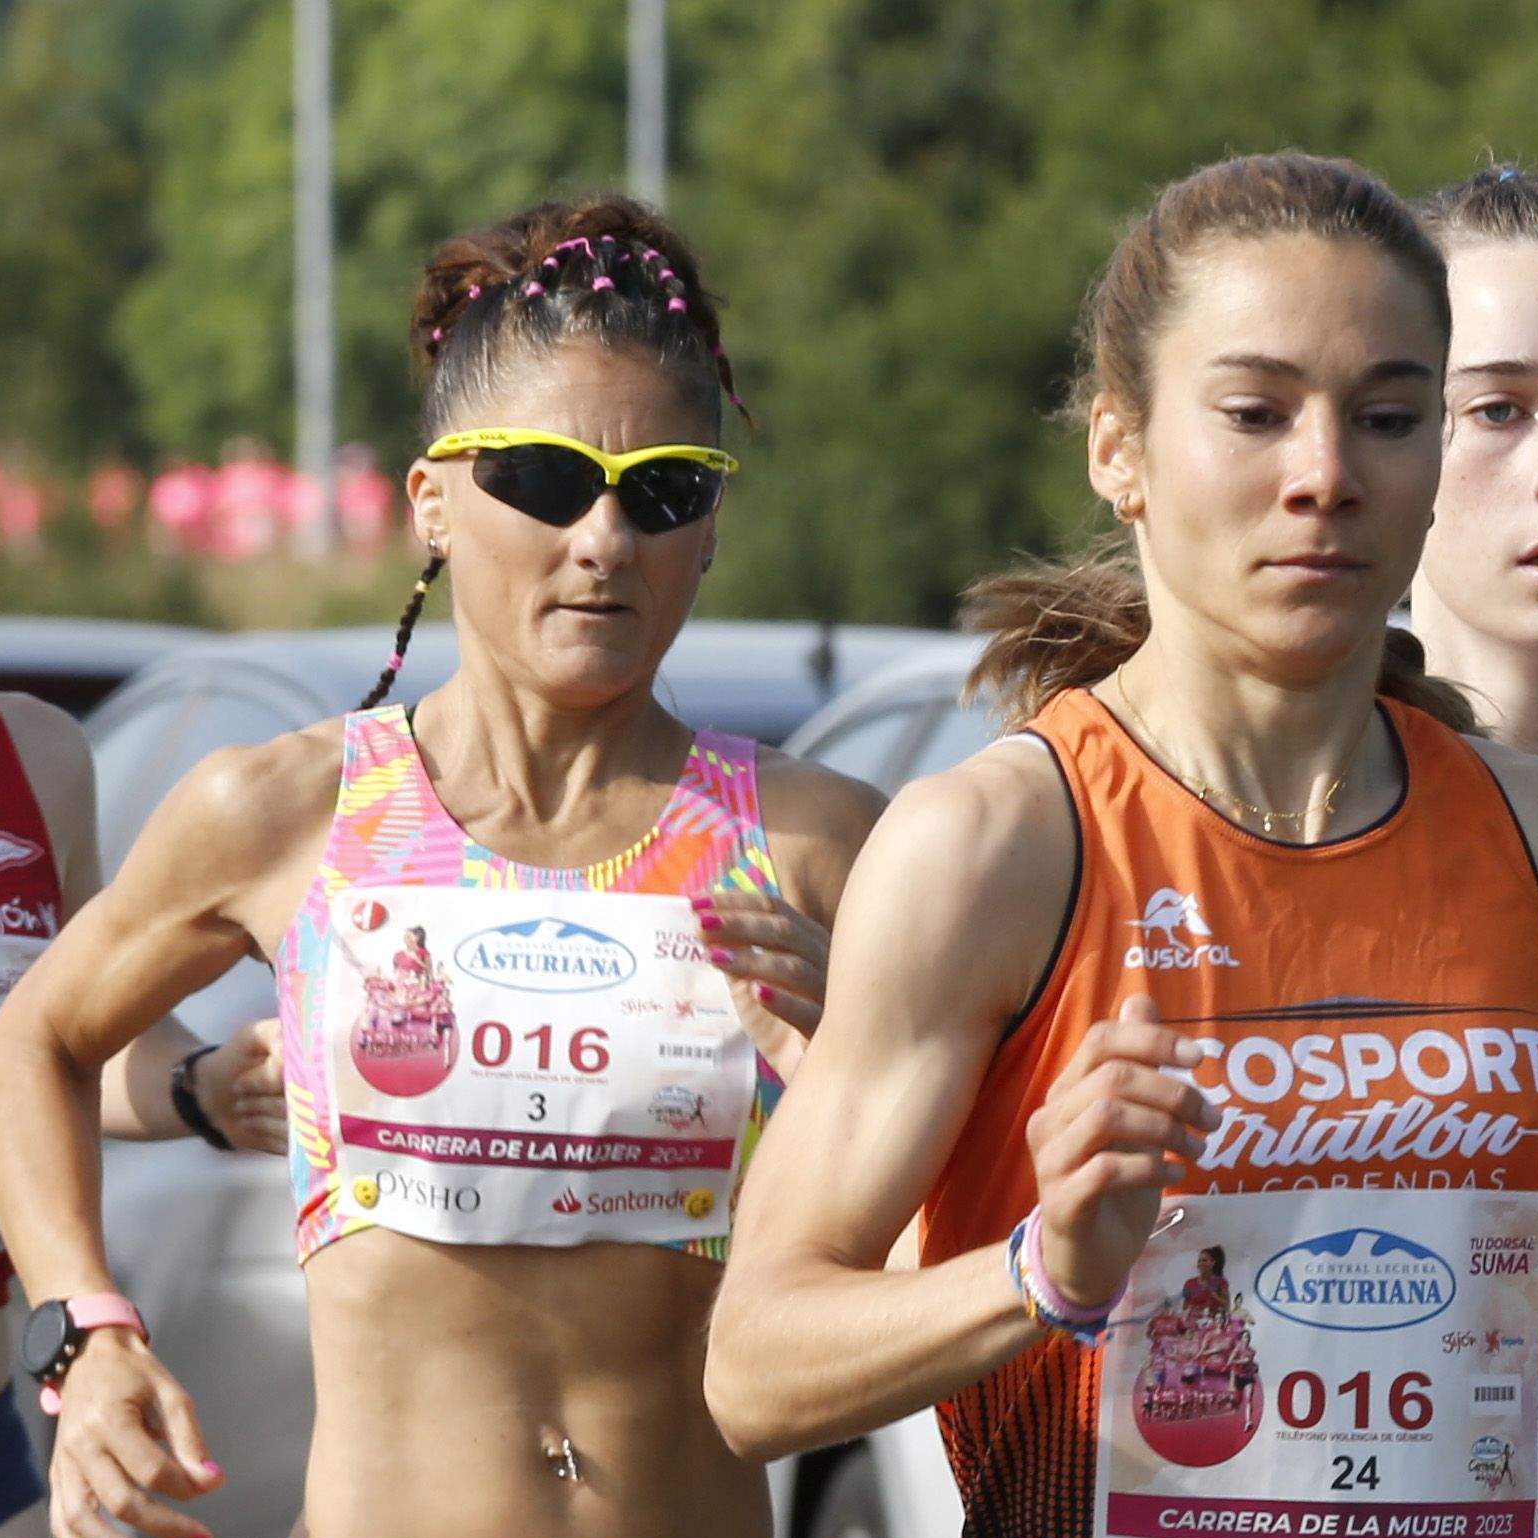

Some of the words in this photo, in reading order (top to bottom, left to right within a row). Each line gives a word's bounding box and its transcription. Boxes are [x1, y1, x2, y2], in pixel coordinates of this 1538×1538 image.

[469, 943, 621, 978] ASTURIANA
[471, 1020, 611, 1074] 016
[527, 1092, 547, 1122] 3
[377, 1128, 483, 1158] CARRERA
[488, 1138, 524, 1160] DE
[527, 1141, 558, 1161] LA
[563, 1143, 642, 1163] MUJER
[375, 1169, 482, 1214] OYSHO
[1470, 1238, 1483, 1250] TU
[1485, 1237, 1535, 1250] DORSAL
[1304, 1263, 1370, 1274] CENTRAL
[1375, 1264, 1438, 1274] LECHERA
[1469, 1252, 1530, 1275] SUMA
[1270, 1264, 1443, 1305] ASTURIANA
[1277, 1369, 1434, 1431] 016
[1330, 1454, 1381, 1490] 24
[1157, 1508, 1292, 1535] CARRERA
[1298, 1513, 1341, 1537] DE
[1344, 1514, 1381, 1537] LA
[1386, 1514, 1468, 1538] MUJER
[1473, 1513, 1515, 1537] 2023
